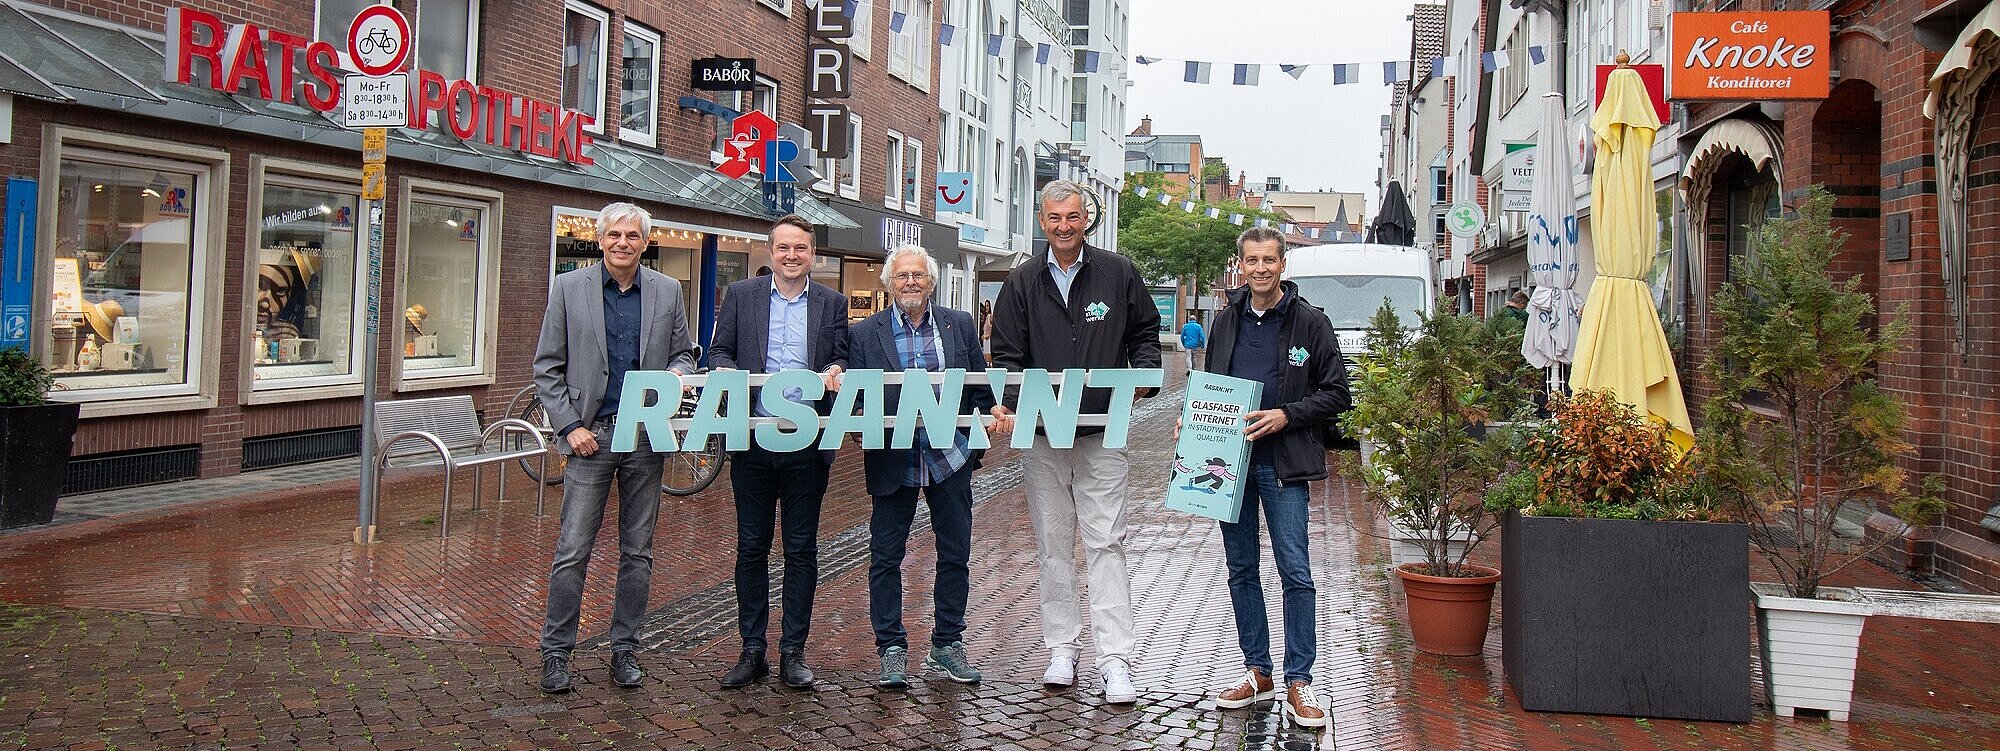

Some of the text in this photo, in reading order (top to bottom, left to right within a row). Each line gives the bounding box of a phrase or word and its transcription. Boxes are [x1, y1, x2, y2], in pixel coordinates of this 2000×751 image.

[1730, 20, 1768, 34] Café
[1684, 36, 1816, 69] Knoke
[167, 7, 340, 112] RATS
[703, 66, 751, 83] BABOR
[360, 81, 391, 92] Mo-Fr
[1707, 76, 1792, 89] Konditorei
[392, 94, 398, 104] h
[348, 110, 357, 120] Sa
[398, 109, 403, 120] h
[265, 213, 281, 228] Wir
[282, 208, 307, 224] bilden
[1191, 400, 1240, 414] GLASFASER
[1192, 413, 1237, 426] INTERNET
[1195, 424, 1239, 436] STADTWERKE
